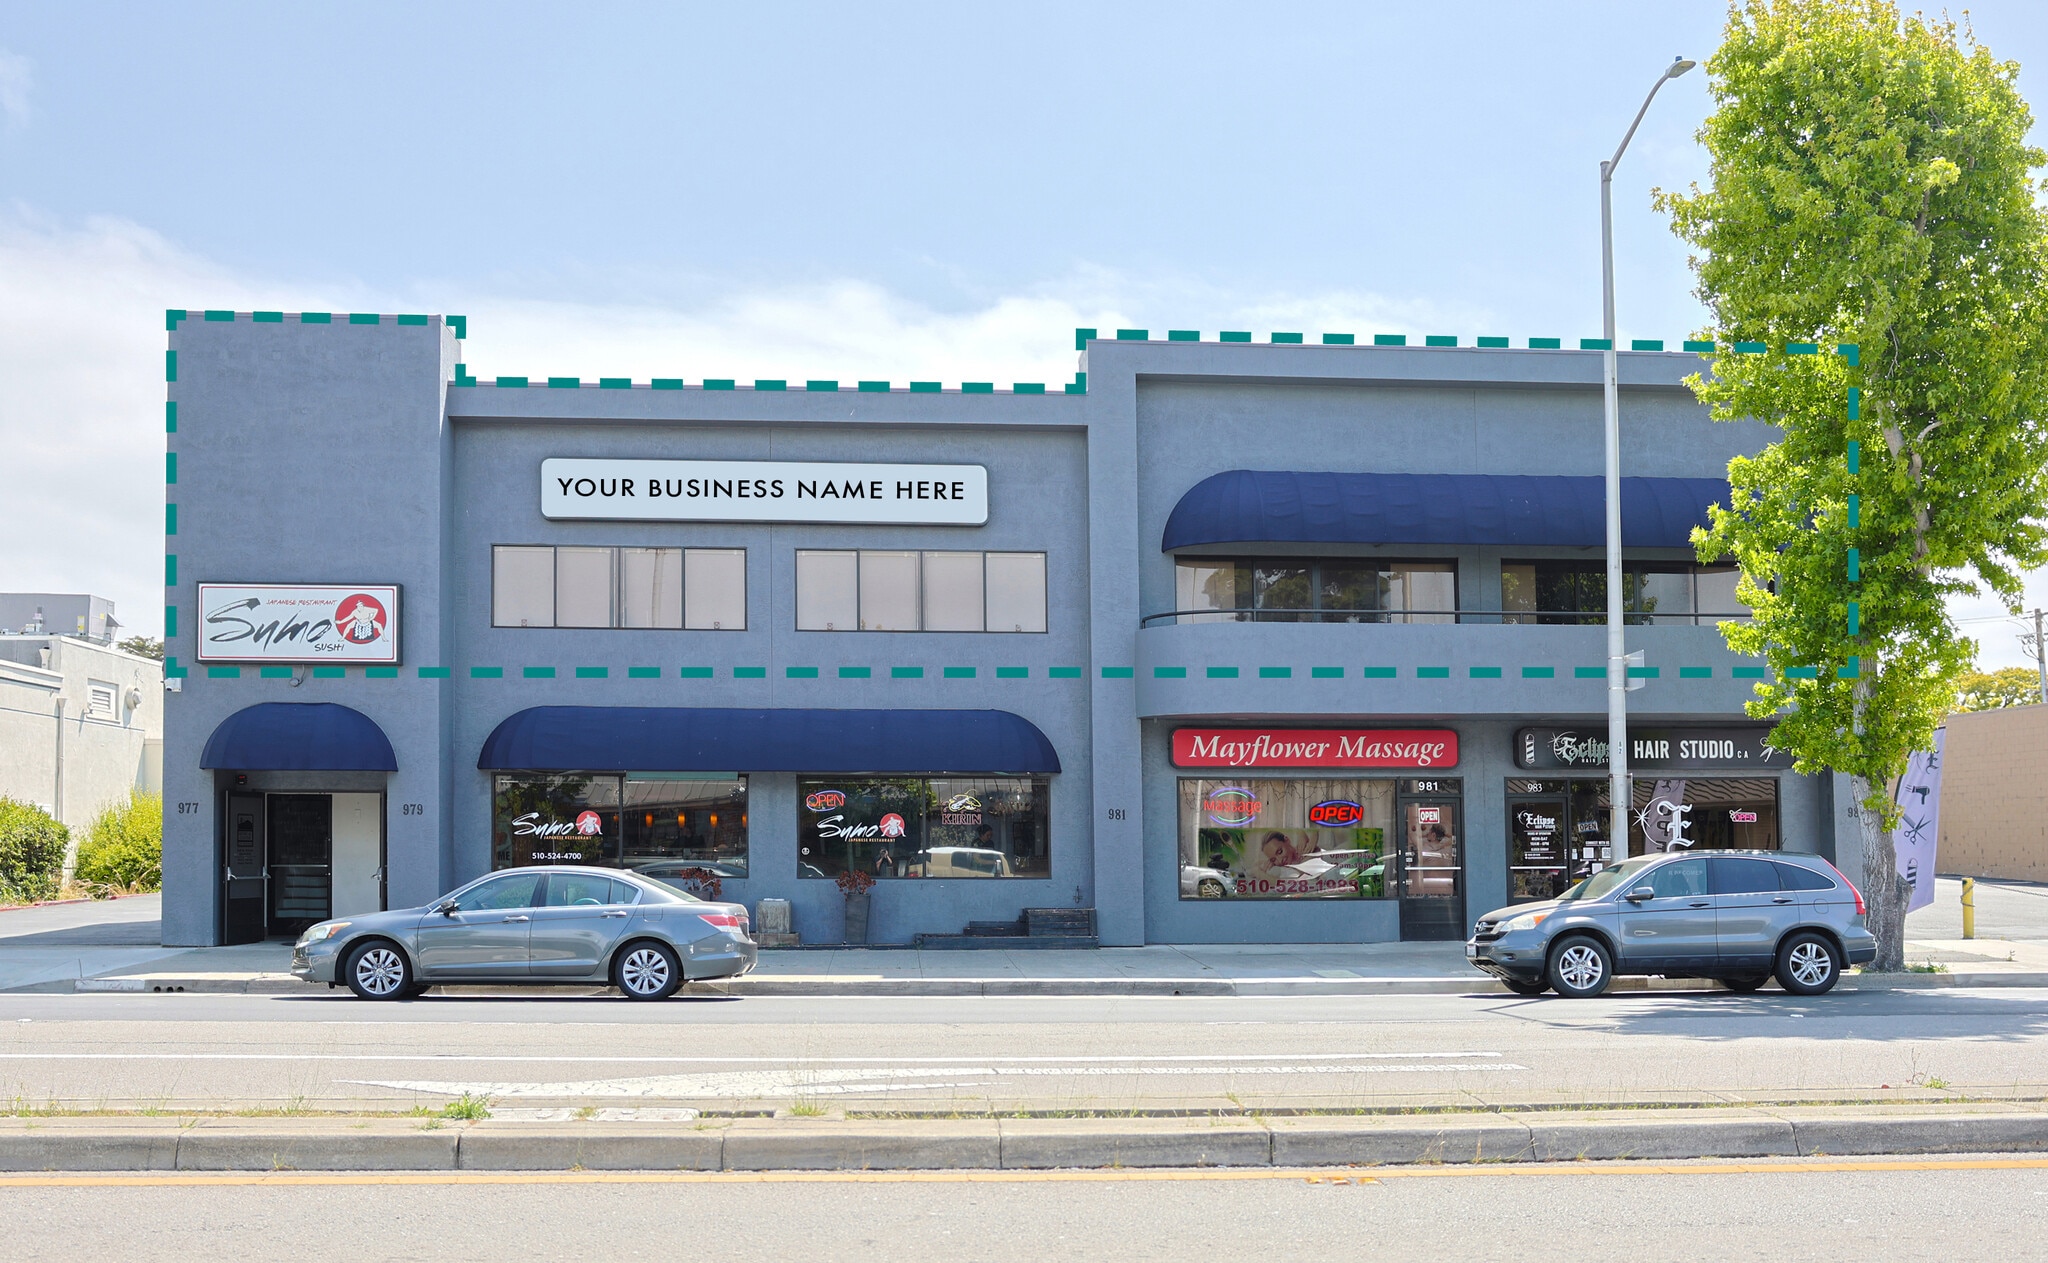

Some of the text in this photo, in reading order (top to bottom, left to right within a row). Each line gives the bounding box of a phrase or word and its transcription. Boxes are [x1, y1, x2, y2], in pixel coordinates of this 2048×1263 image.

[557, 477, 965, 500] YOUR BUSINESS NAME HERE
[314, 643, 345, 652] SUSHI
[1189, 735, 1446, 767] Mayflower Massage
[1634, 740, 1670, 759] HAIR
[1680, 740, 1734, 759] STUDIO
[1418, 781, 1439, 791] 981
[1527, 783, 1543, 793] 983
[806, 794, 845, 807] OPEN
[178, 802, 199, 814] 977
[402, 803, 424, 816] 979
[1203, 800, 1262, 816] Massage
[1310, 806, 1364, 822] OPEN
[1847, 806, 1859, 818] 98
[941, 813, 982, 825] KIRIN
[1108, 808, 1127, 821] 981
[1420, 811, 1438, 821] OPEN
[1523, 812, 1556, 829] Eclipse
[1735, 813, 1756, 821] OPEN
[1580, 822, 1598, 831] OPEN
[532, 852, 582, 860] 510-524-4700
